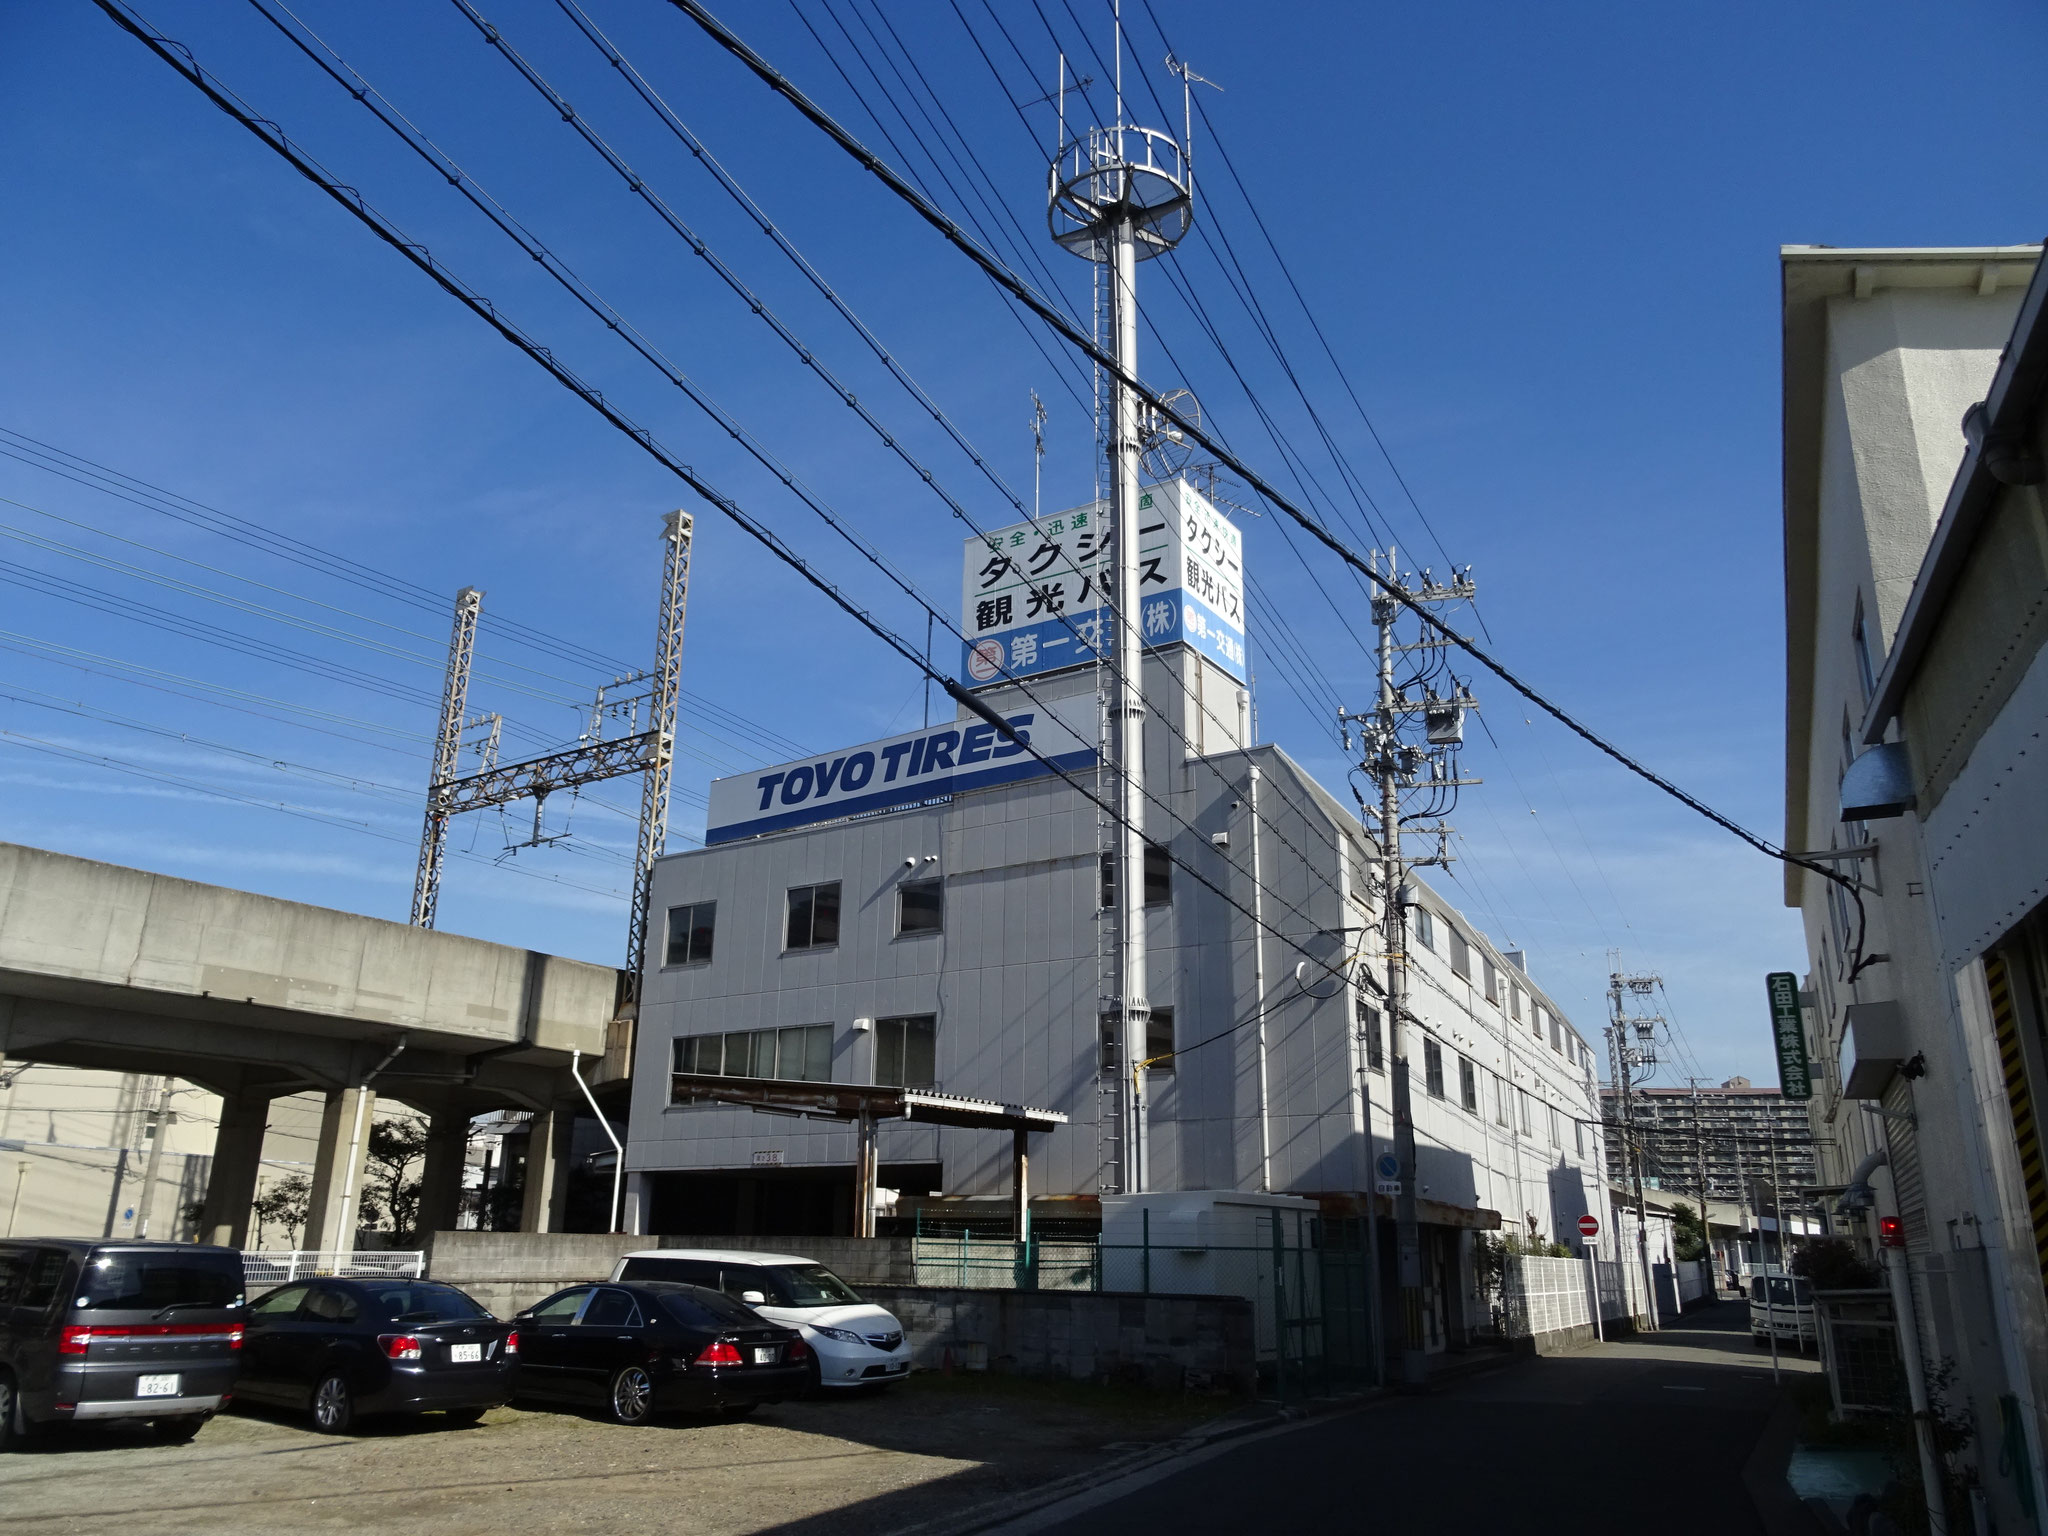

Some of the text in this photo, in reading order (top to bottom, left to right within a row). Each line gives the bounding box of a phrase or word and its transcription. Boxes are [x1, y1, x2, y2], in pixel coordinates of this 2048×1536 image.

[979, 523, 1165, 589] タクシー
[1186, 514, 1239, 573] タクシー
[976, 557, 1168, 631] 観光バス
[1186, 555, 1241, 624] 観光バス
[1010, 598, 1177, 670] 第一交(株)
[757, 713, 1035, 811] TOYO TIRES
[1771, 975, 1807, 1097] 石田工業株式会社
[146, 1382, 174, 1394] 82-61
[458, 1350, 480, 1360] 85-66
